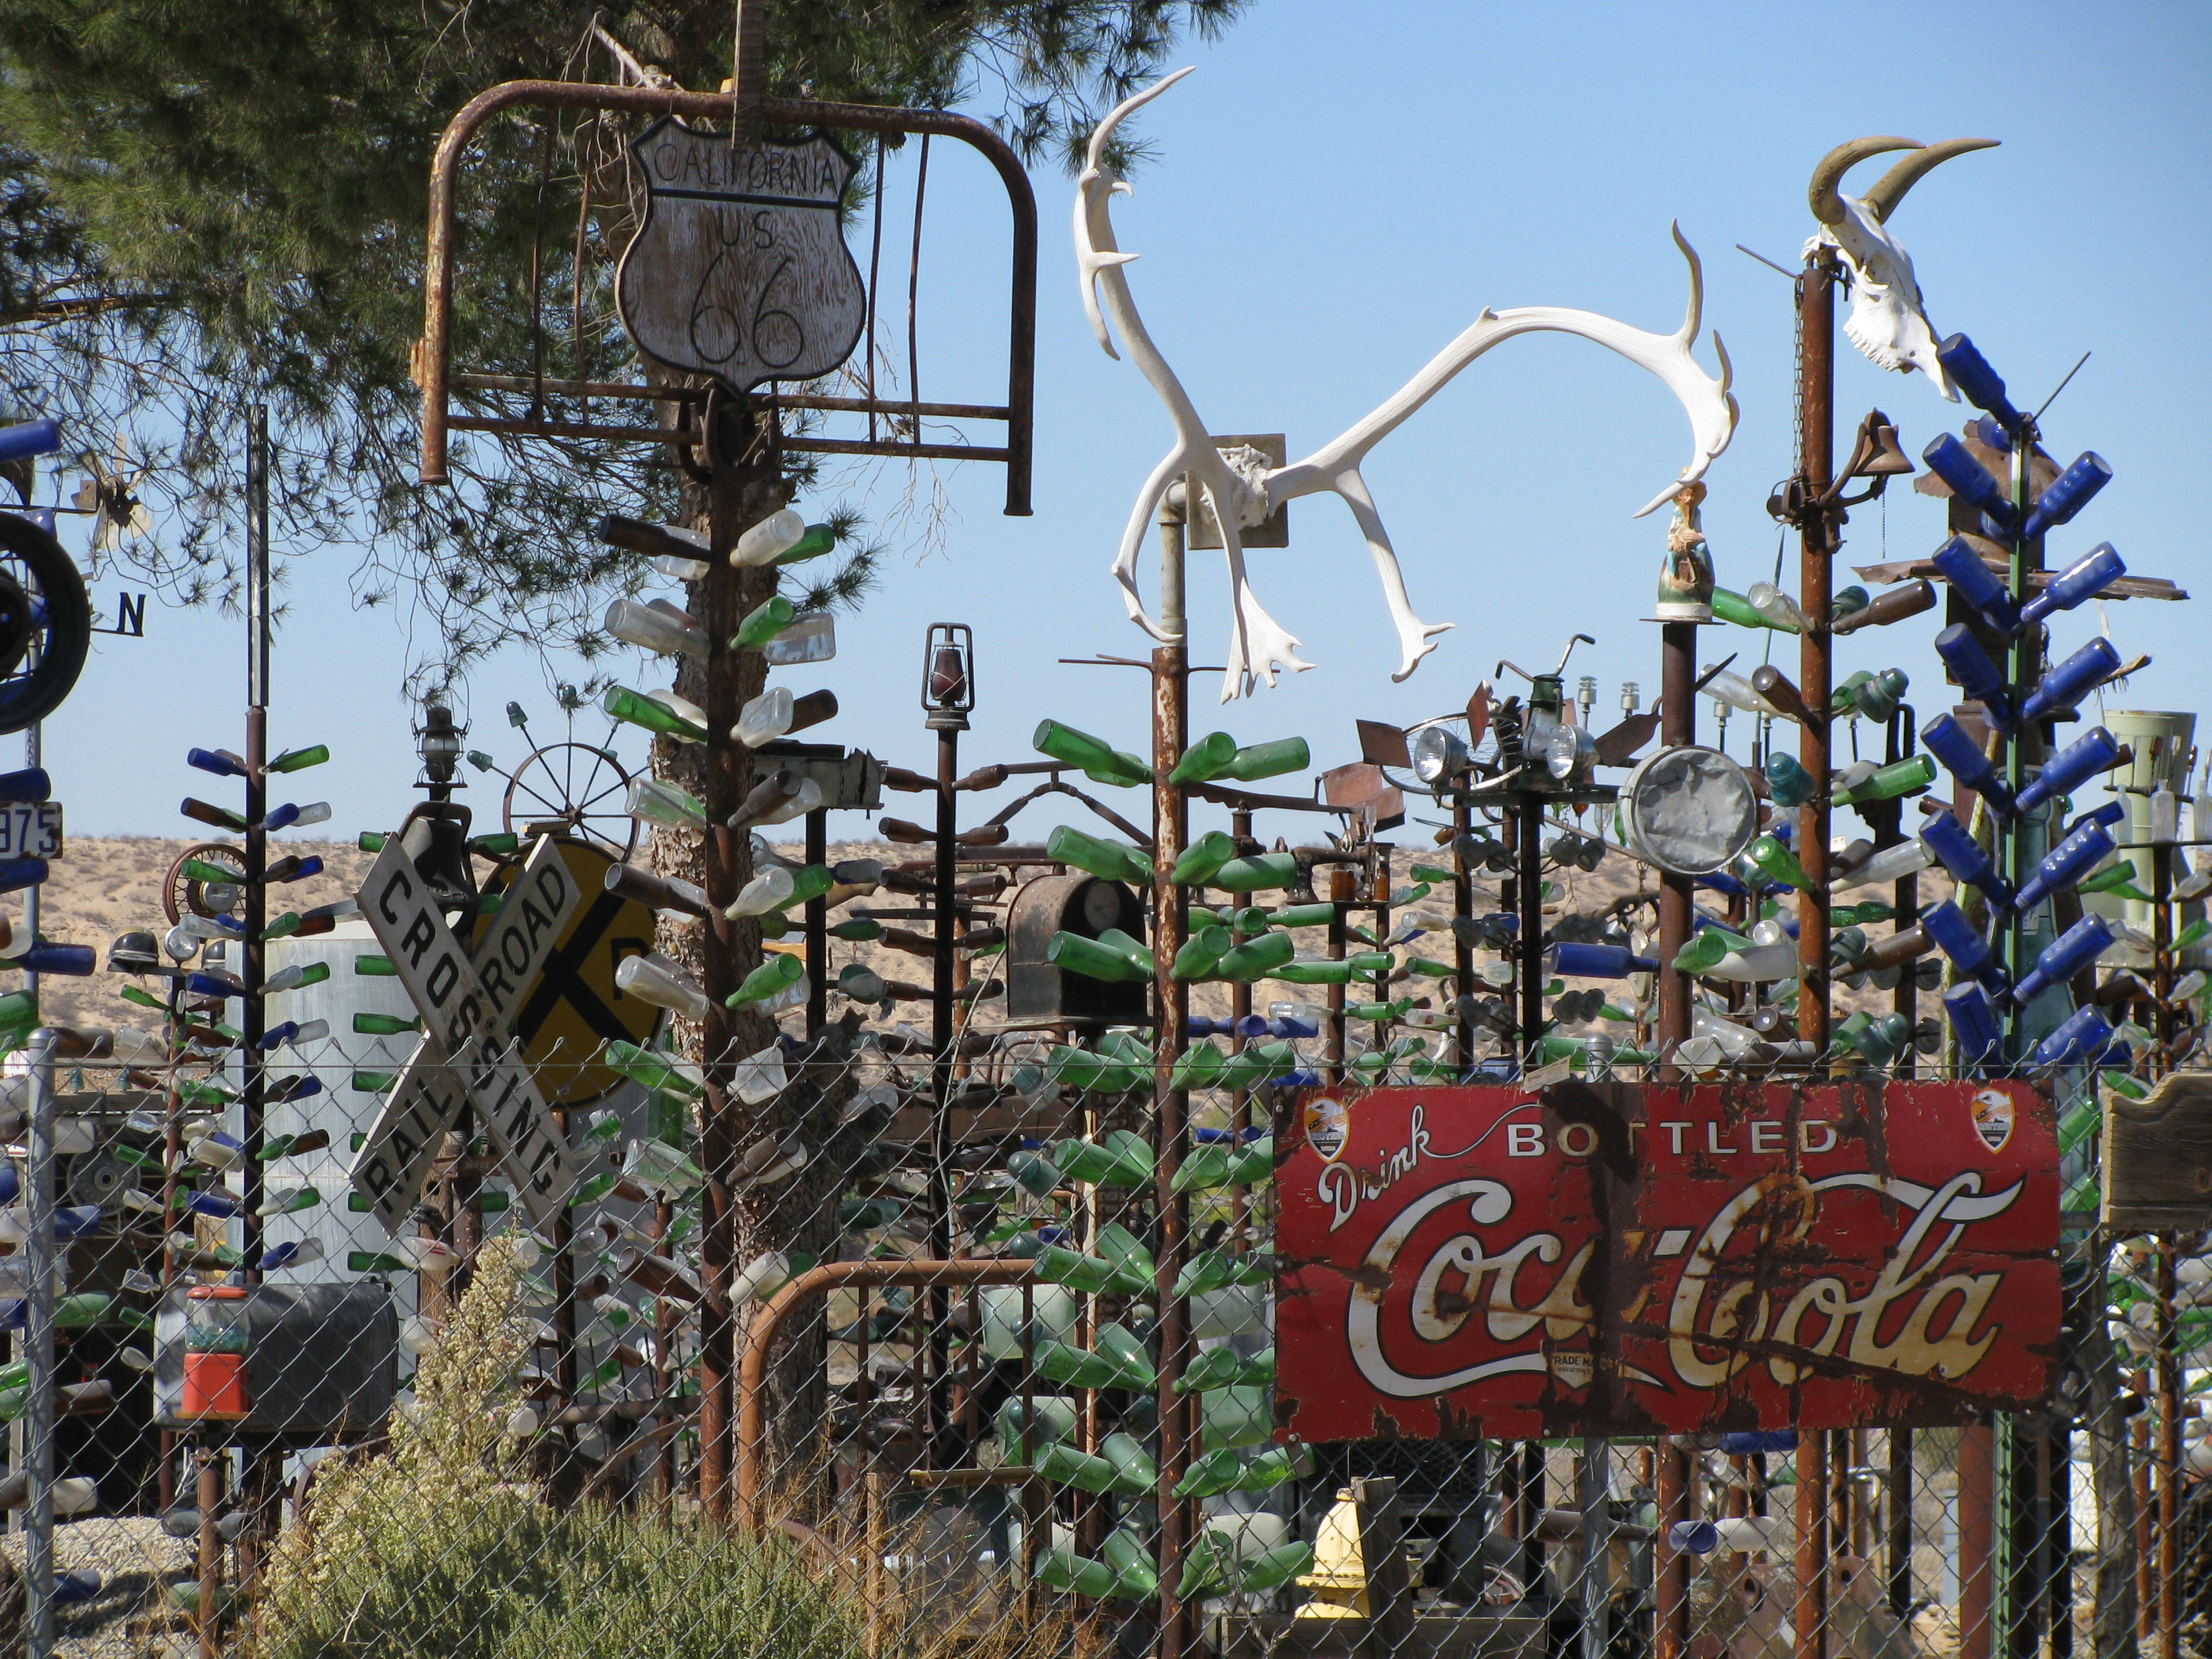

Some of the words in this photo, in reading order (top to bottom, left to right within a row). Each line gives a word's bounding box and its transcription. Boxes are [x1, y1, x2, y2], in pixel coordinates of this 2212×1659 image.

[654, 143, 839, 194] CALIFORNIA
[689, 251, 805, 369] 66
[117, 592, 144, 636] N
[363, 1078, 453, 1216] RAIL
[478, 863, 567, 1014] ROAD
[379, 869, 562, 1195] CROSSING
[1317, 1104, 1484, 1233] Drink
[1506, 1120, 1838, 1158] BOTTLED
[1552, 1355, 1580, 1365] RADE
